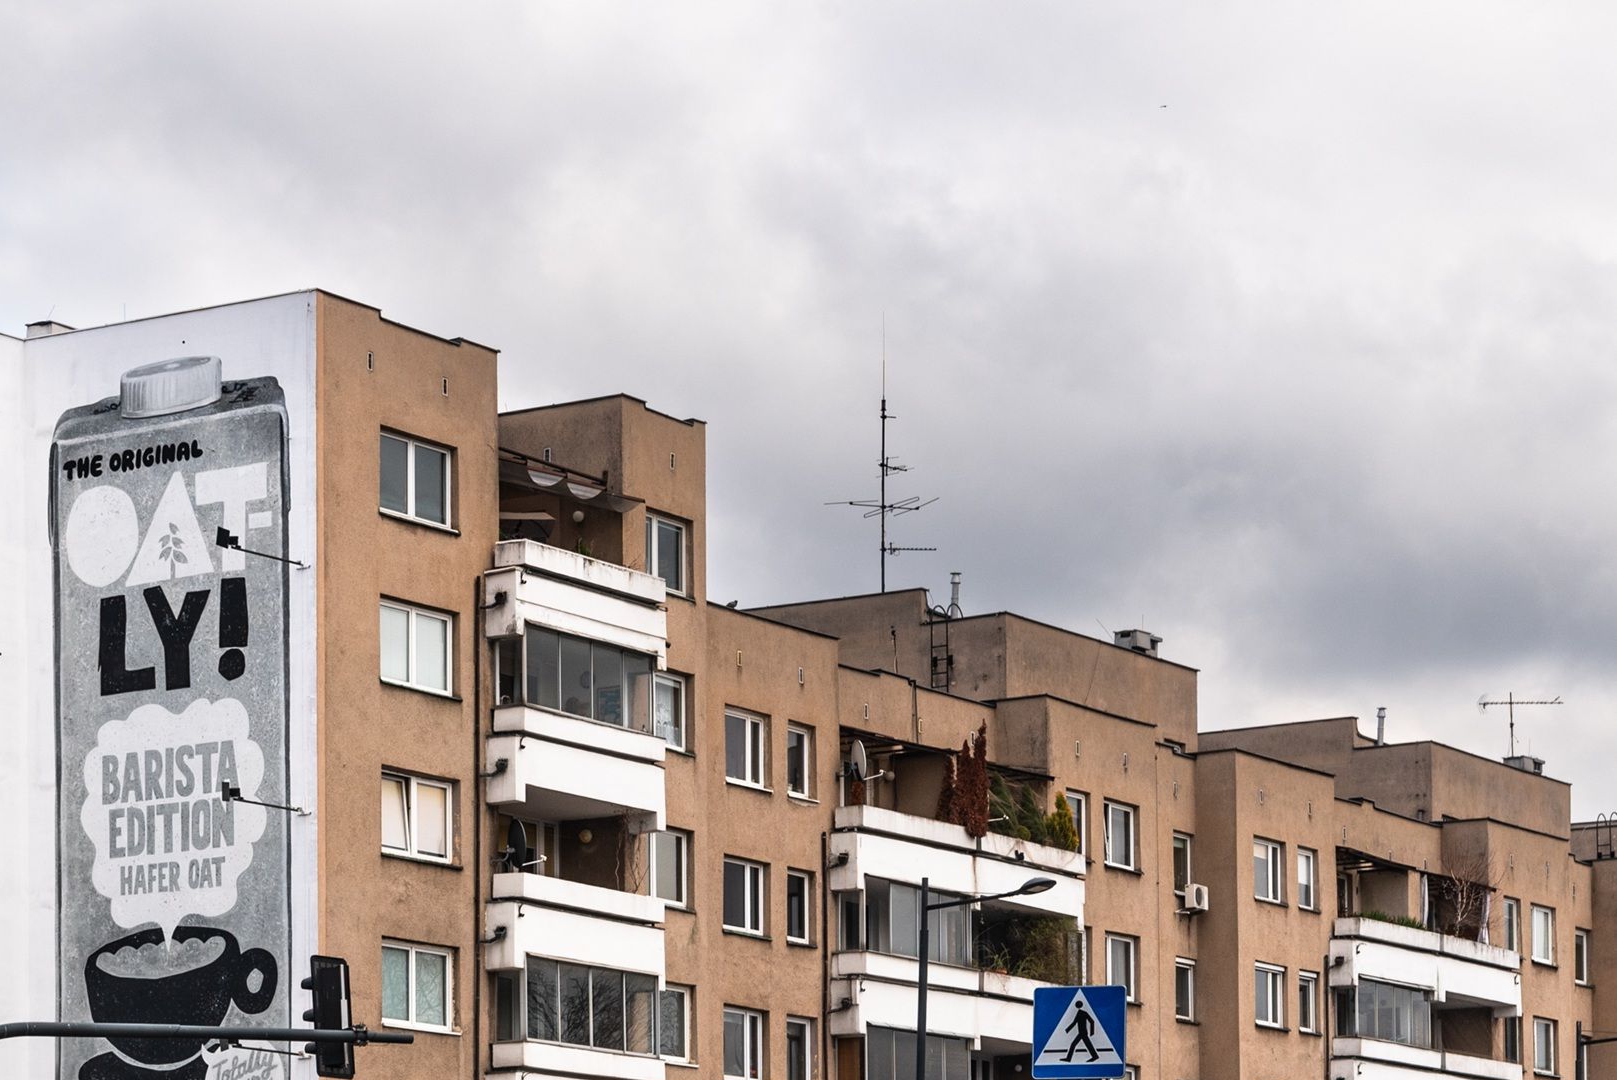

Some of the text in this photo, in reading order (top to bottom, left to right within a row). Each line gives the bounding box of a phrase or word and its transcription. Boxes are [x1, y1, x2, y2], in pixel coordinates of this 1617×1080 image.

[63, 440, 203, 480] THE ORIGINAL
[98, 577, 249, 696] LY!
[101, 740, 239, 804] BARISTA
[108, 800, 235, 859] EDITION
[120, 856, 226, 895] HAFER OAT
